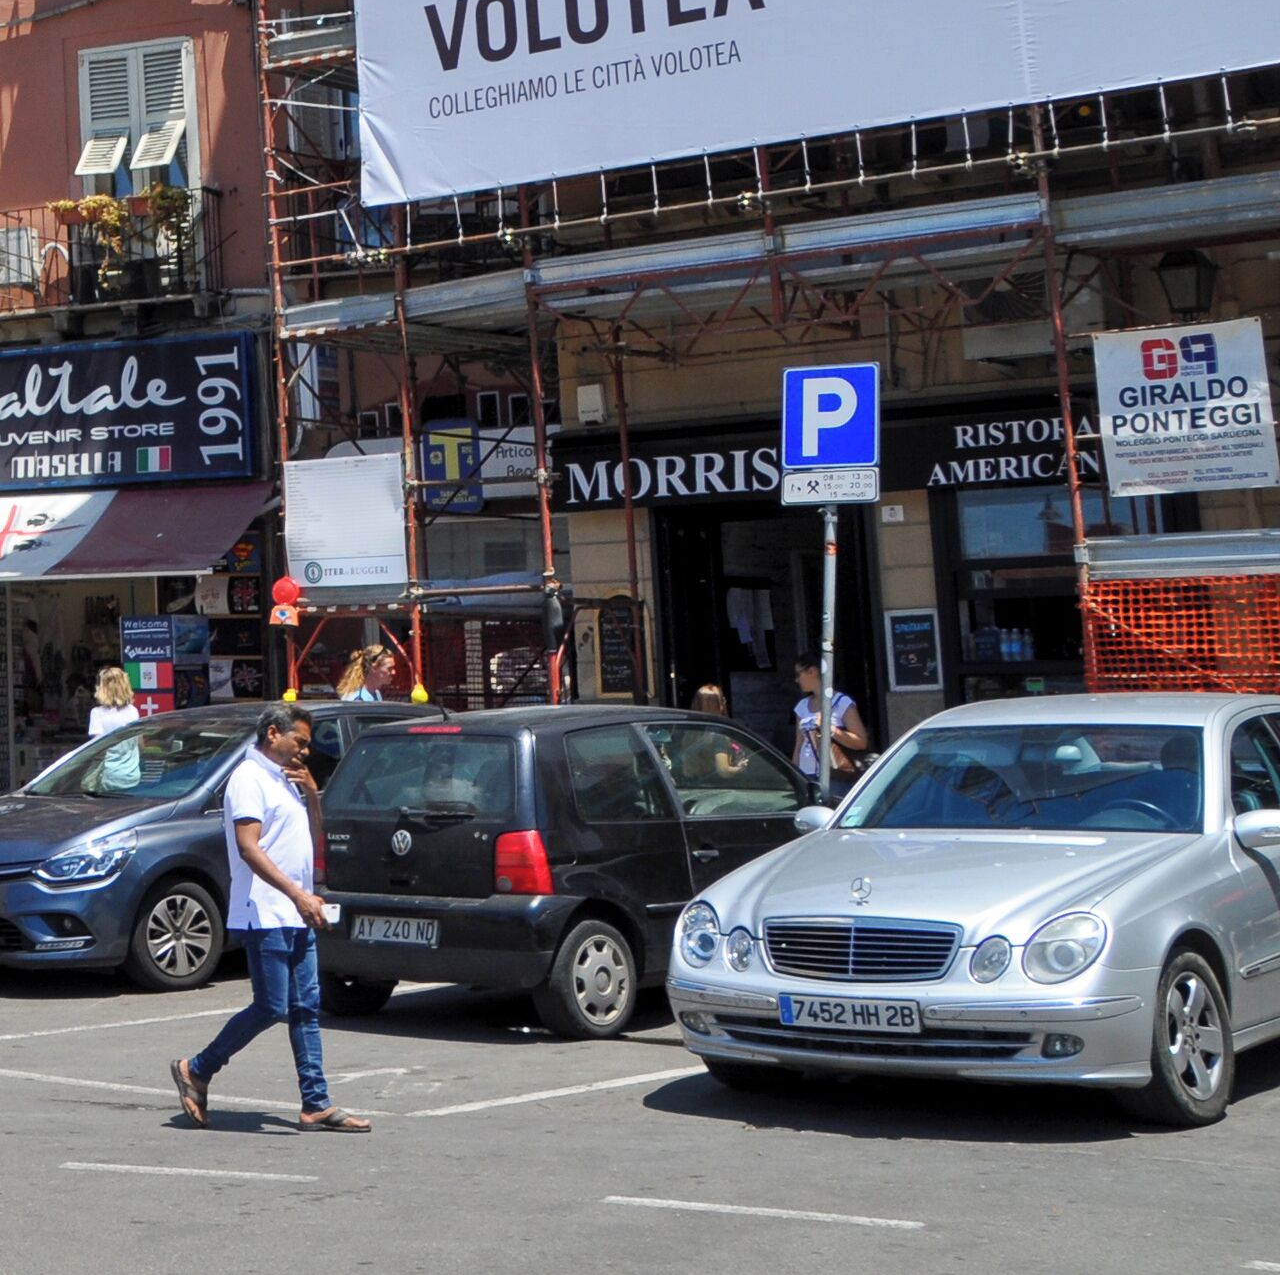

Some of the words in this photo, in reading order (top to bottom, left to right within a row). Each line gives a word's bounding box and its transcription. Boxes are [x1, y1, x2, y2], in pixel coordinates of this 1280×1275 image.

[428, 74, 558, 119] COLLEGHIAMO
[564, 69, 587, 95] LE
[591, 53, 647, 89] CITTÀ
[650, 39, 742, 77] VOLOTEA
[194, 345, 244, 466] 1991
[1118, 375, 1249, 408] GIRALDO
[89, 422, 175, 441] STORE
[801, 376, 859, 457] P
[1111, 402, 1262, 436] PONTEGGI
[1116, 436, 1161, 447] NOLEGGIO
[1162, 433, 1209, 444] PONTEGGI
[1210, 429, 1262, 441] SARDEGNA
[123, 620, 169, 629] Welcome
[357, 917, 376, 938] AY
[382, 919, 411, 940] 240
[415, 921, 436, 941] ND
[793, 1000, 847, 1024] 7452
[851, 1003, 881, 1026] HH
[884, 1005, 916, 1027] 2B
